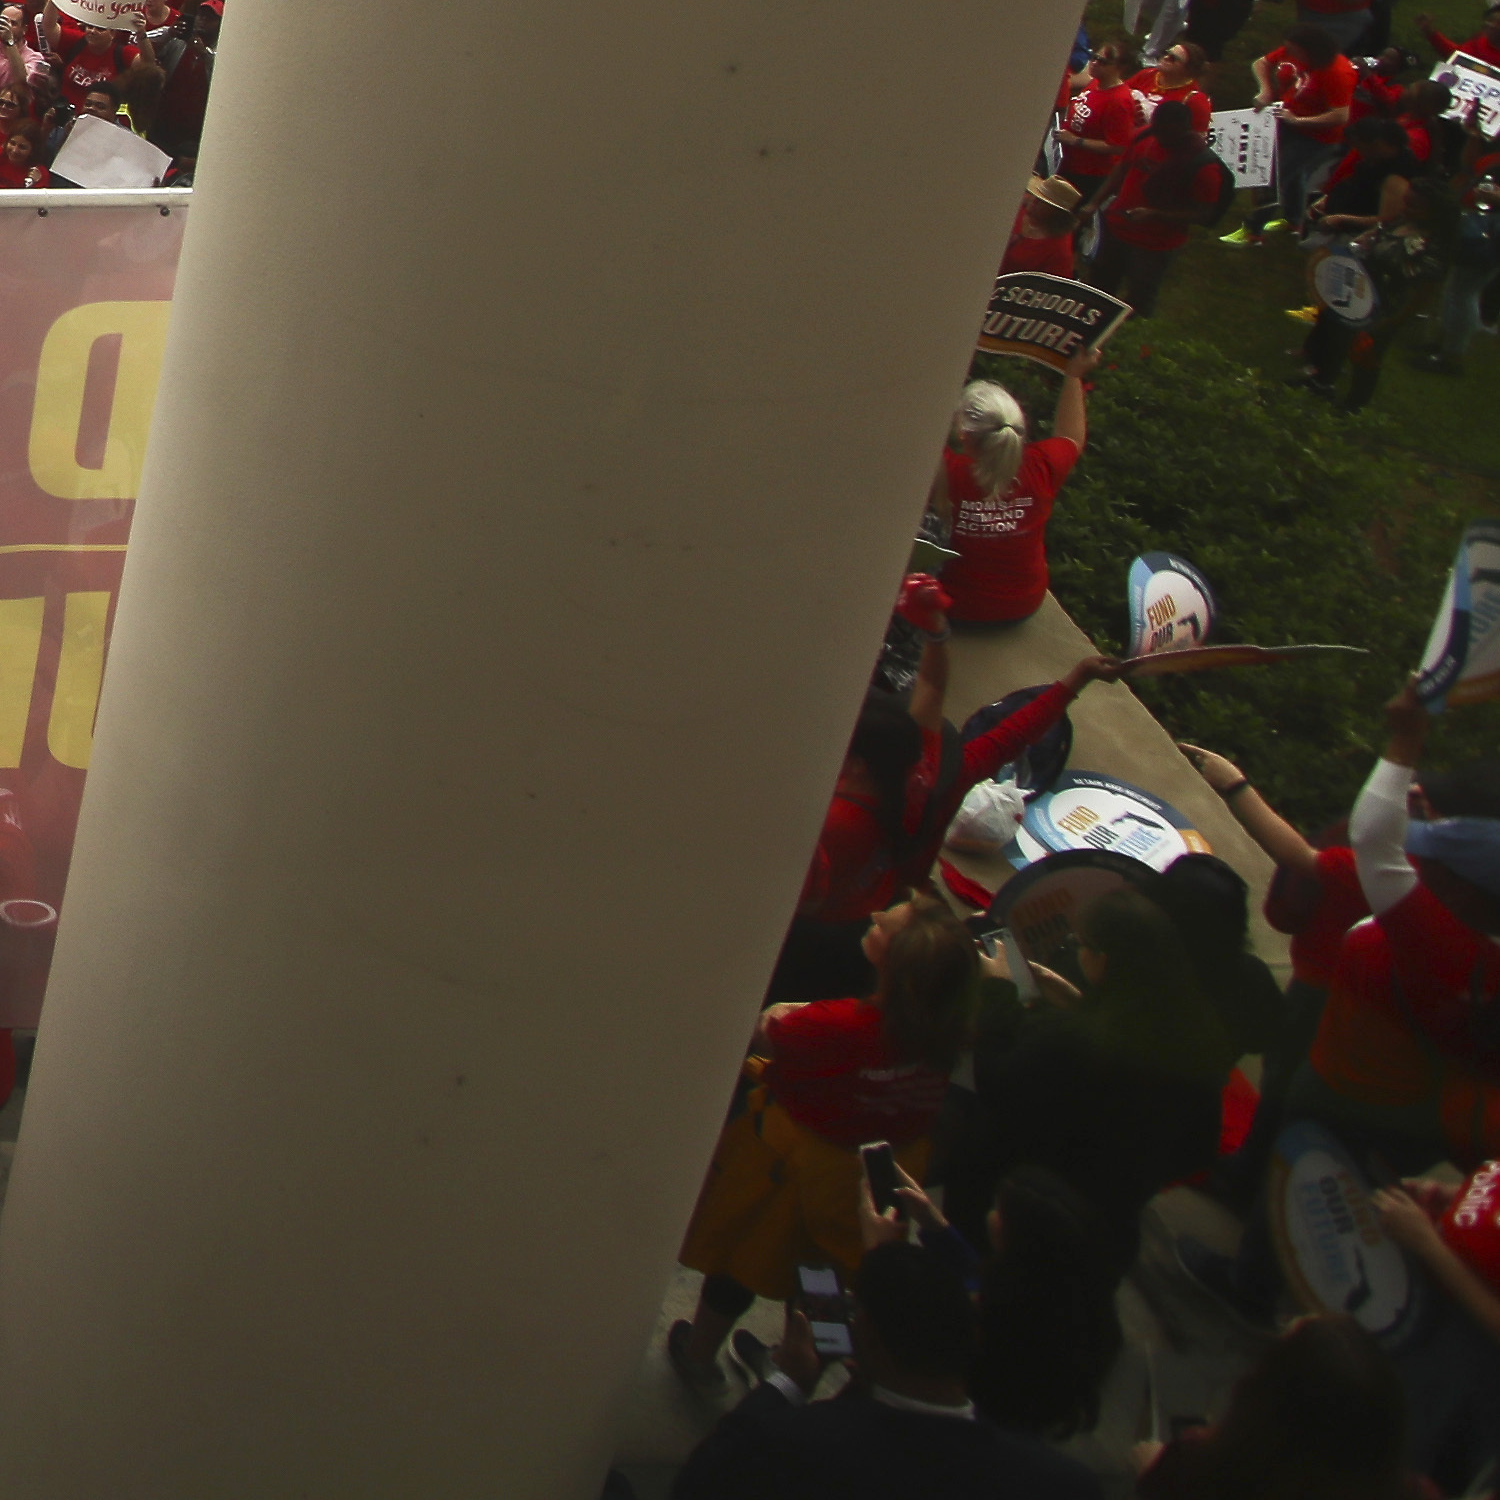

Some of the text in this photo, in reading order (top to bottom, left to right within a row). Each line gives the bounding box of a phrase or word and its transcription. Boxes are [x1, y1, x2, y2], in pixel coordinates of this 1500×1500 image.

[110, 0, 147, 24] you
[1003, 283, 1101, 327] SCHOOLS
[956, 520, 1018, 534] ACTION
[959, 509, 1025, 522] DEMAND
[1147, 594, 1177, 627] FUND
[1149, 621, 1175, 649] OUR
[1057, 805, 1098, 837] FUND
[1082, 823, 1119, 850] OUR
